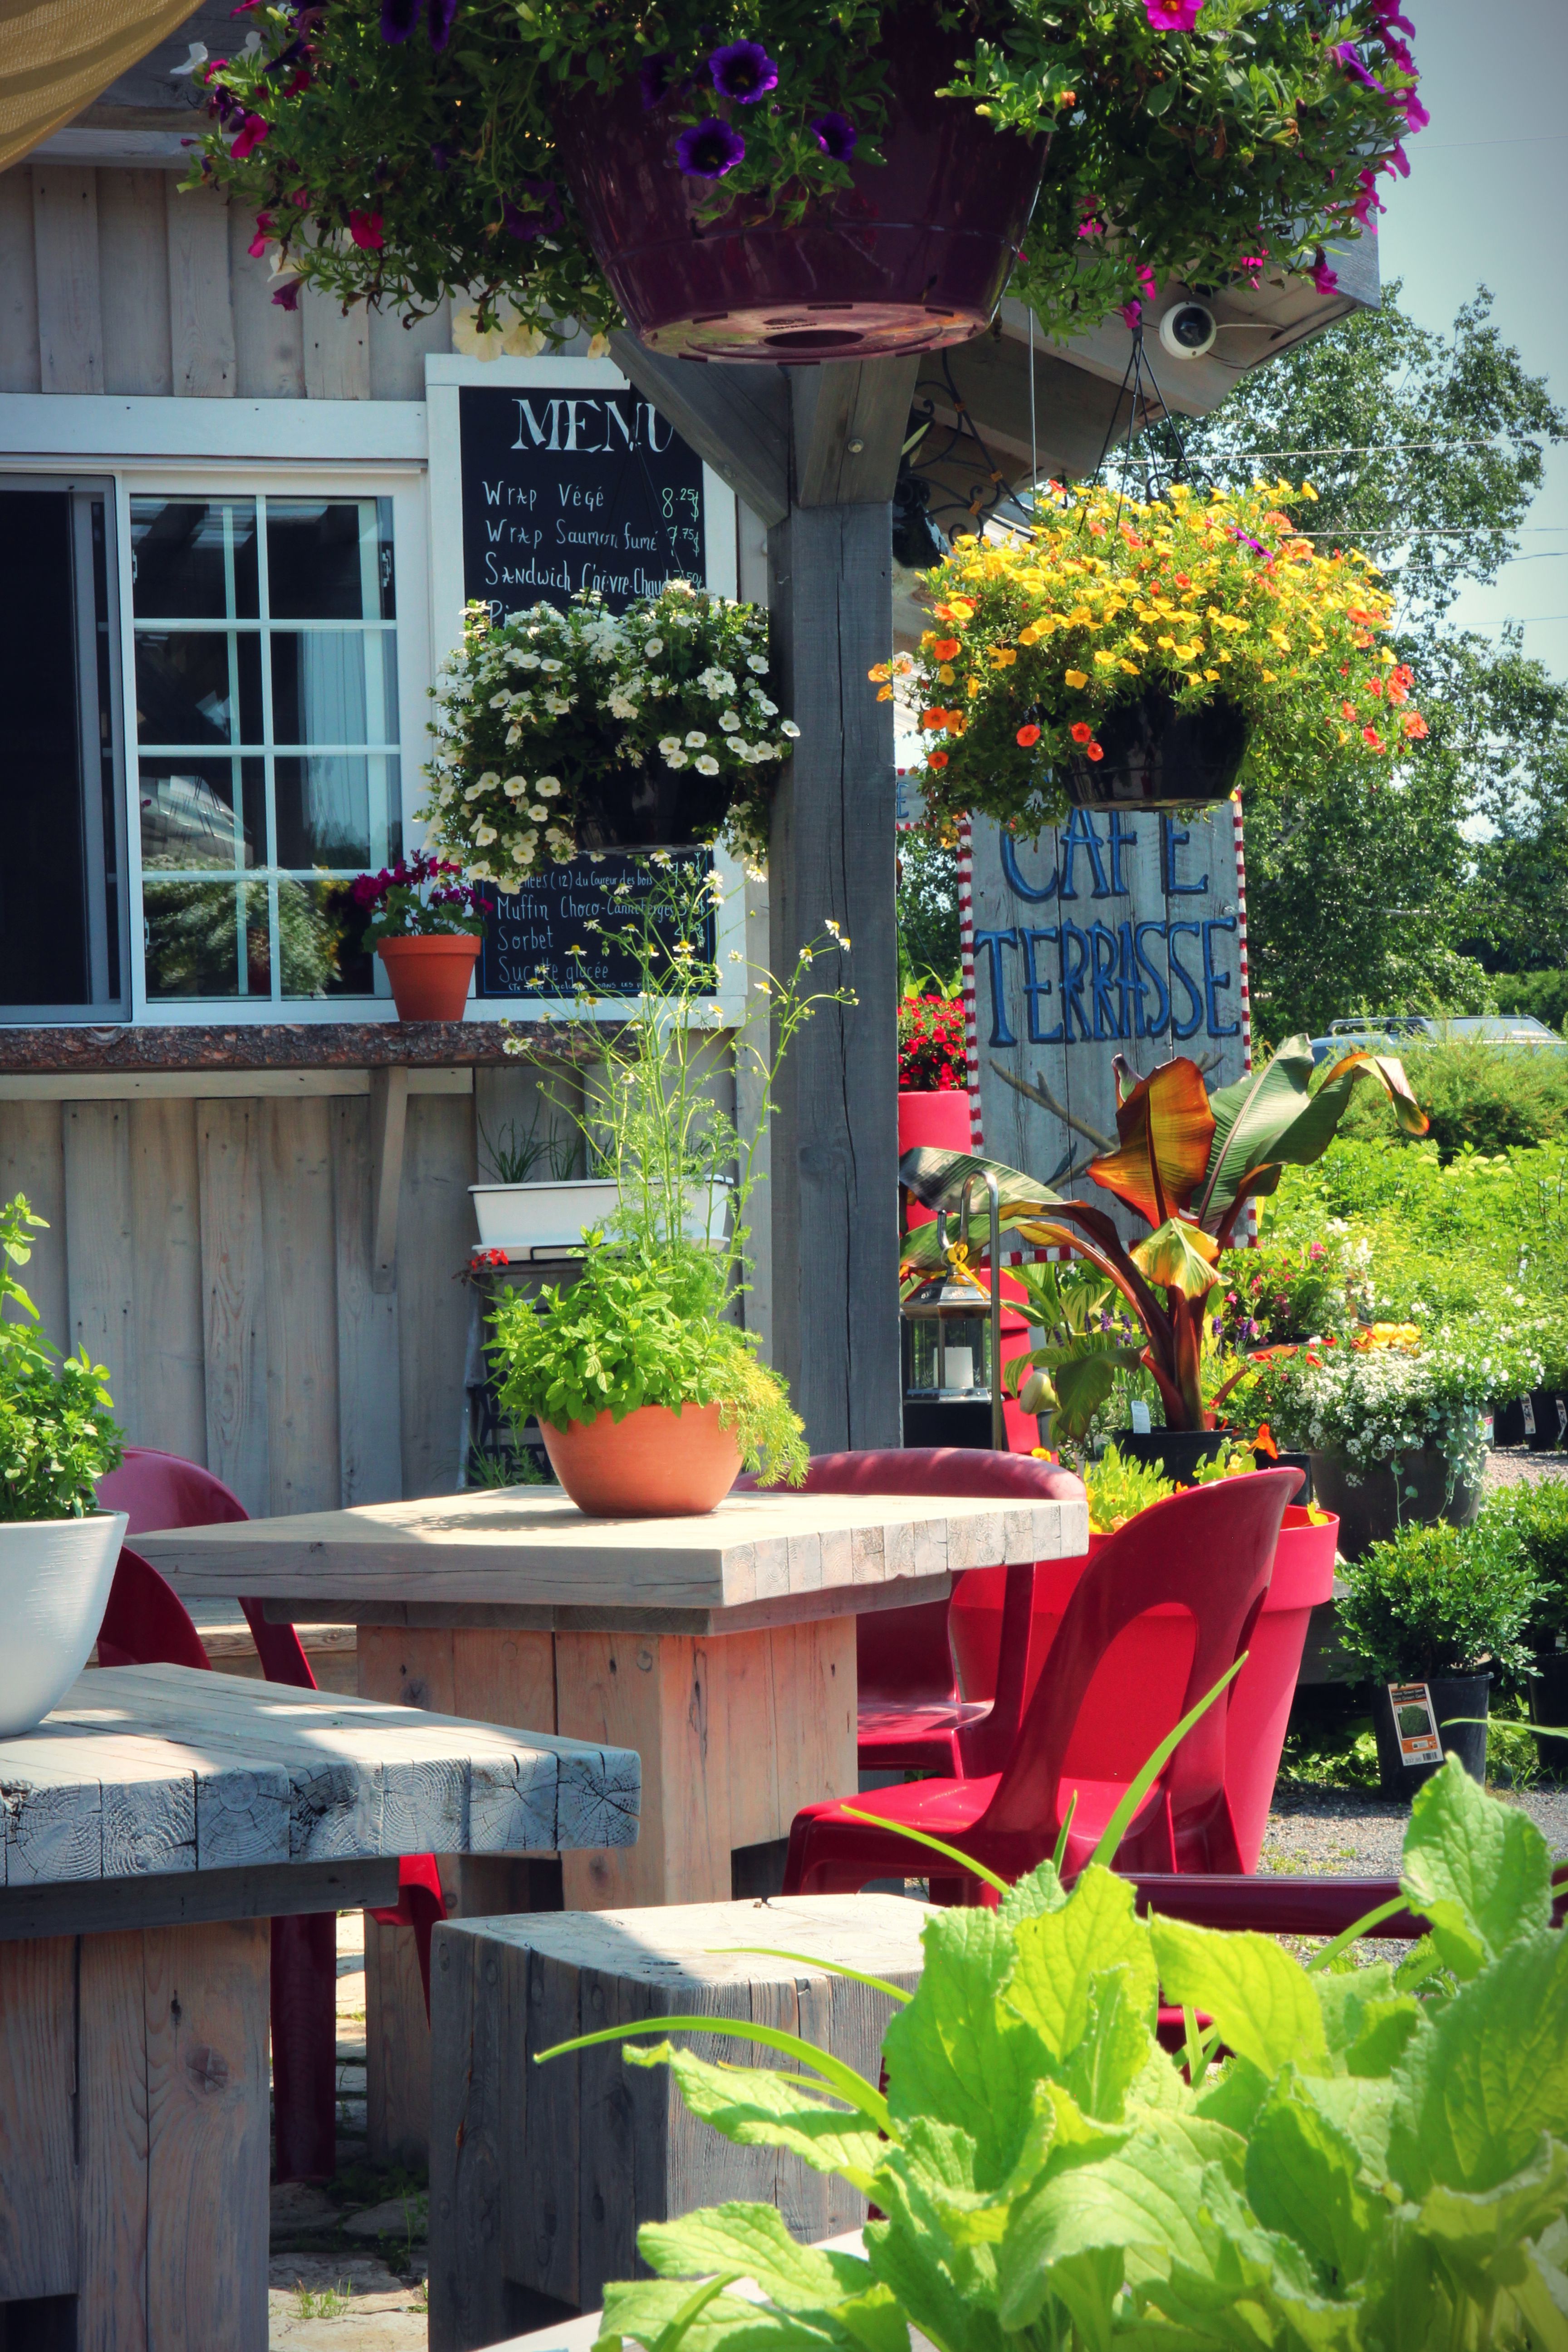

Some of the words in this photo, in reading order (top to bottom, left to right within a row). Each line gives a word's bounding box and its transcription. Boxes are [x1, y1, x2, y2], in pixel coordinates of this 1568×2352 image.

[511, 399, 673, 452] MENU
[556, 519, 618, 549] Saumon
[624, 522, 658, 551] fumé
[575, 871, 588, 887] du
[620, 869, 635, 885] des
[637, 868, 653, 886] bois
[497, 894, 549, 921] Muffin
[498, 925, 554, 951] Sorbet
[973, 916, 1240, 1048] TERRASSE
